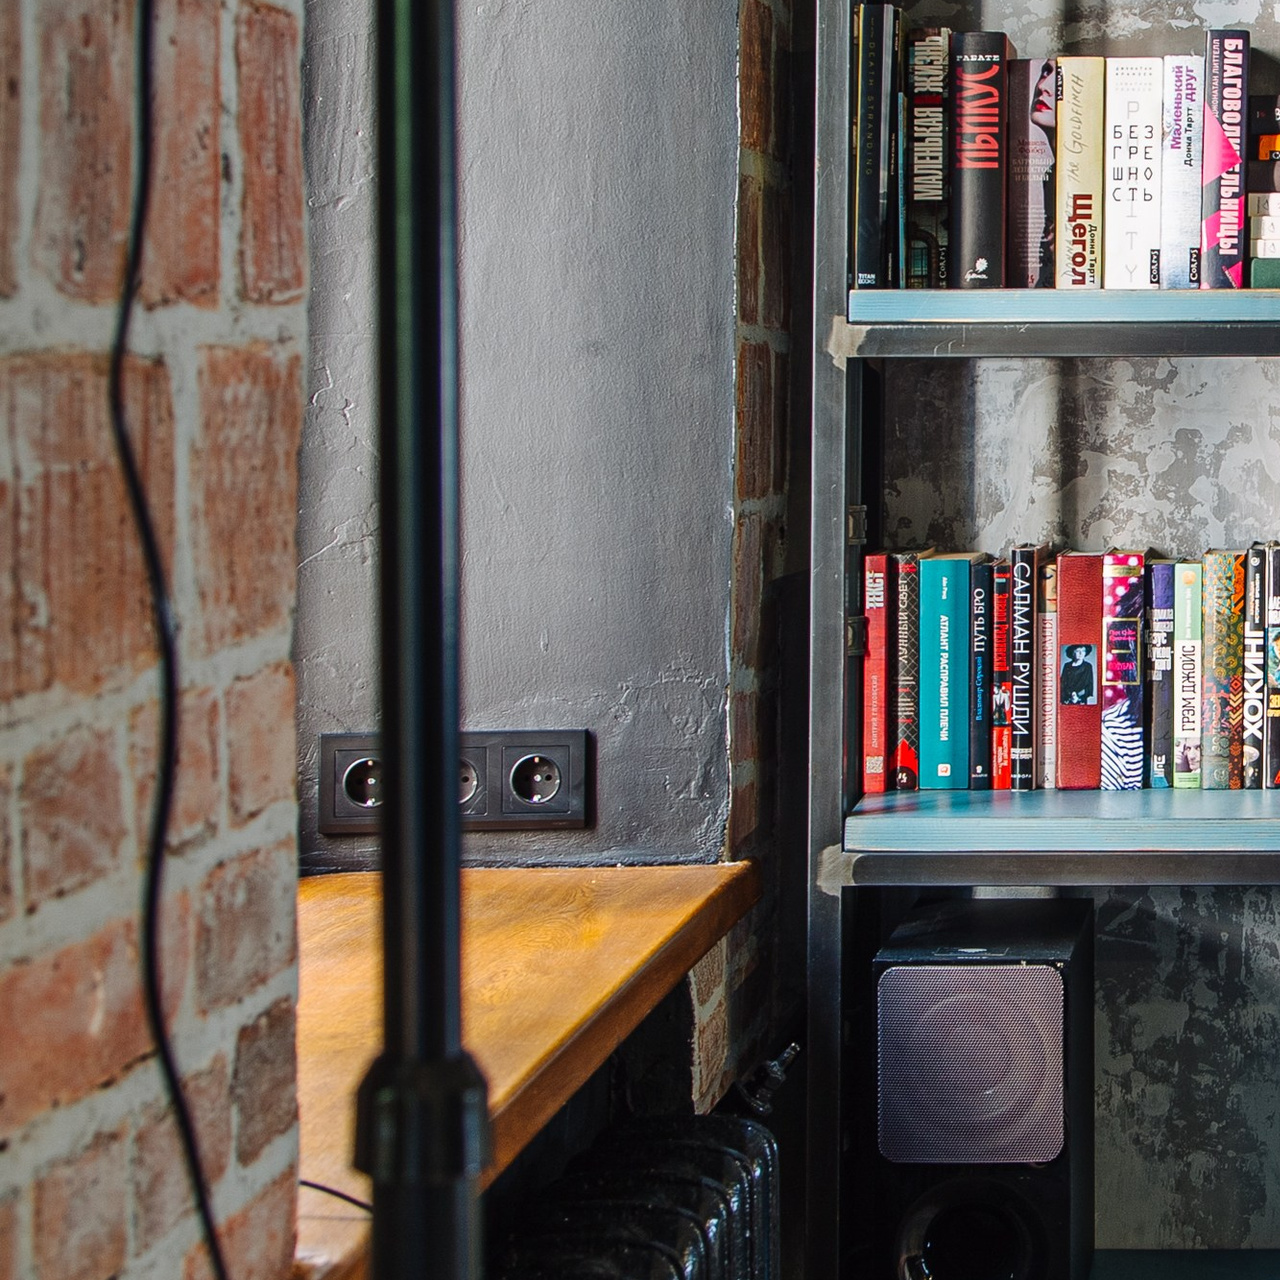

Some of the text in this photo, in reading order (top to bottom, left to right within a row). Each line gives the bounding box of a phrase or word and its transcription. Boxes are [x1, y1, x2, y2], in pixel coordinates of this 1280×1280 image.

[1185, 65, 1197, 102] друг
[1212, 39, 1220, 73] ЛИТТЕЛЛ
[913, 36, 943, 200] МАЛЕНЬКАЯ ЖИЗНЬ
[1113, 125, 1154, 139] БЕЗ
[1170, 65, 1183, 150] Маленький
[1184, 107, 1195, 167] Донна Тартт
[1112, 166, 1153, 181] ШНО
[1113, 146, 1153, 160] ГРЕ
[1112, 187, 1153, 202] СТЬ
[1068, 194, 1092, 285] Щегол
[1087, 224, 1098, 284] Донна Тартт
[973, 588, 987, 652] ПУТЬ БРО
[1013, 562, 1031, 654] САЛМАН
[1042, 617, 1054, 659] ЗЕМЛЯ
[940, 615, 949, 741] АТЛАНТ РАСПРАВИЛ ПЛЕЧИ
[1011, 662, 1031, 735] РУШДИ
[1042, 662, 1054, 746] БЕЗМОЛВНАЯ
[1180, 645, 1196, 731] ГРЭМ ДЖОЙС
[1243, 621, 1264, 740] ХОКИНГ
